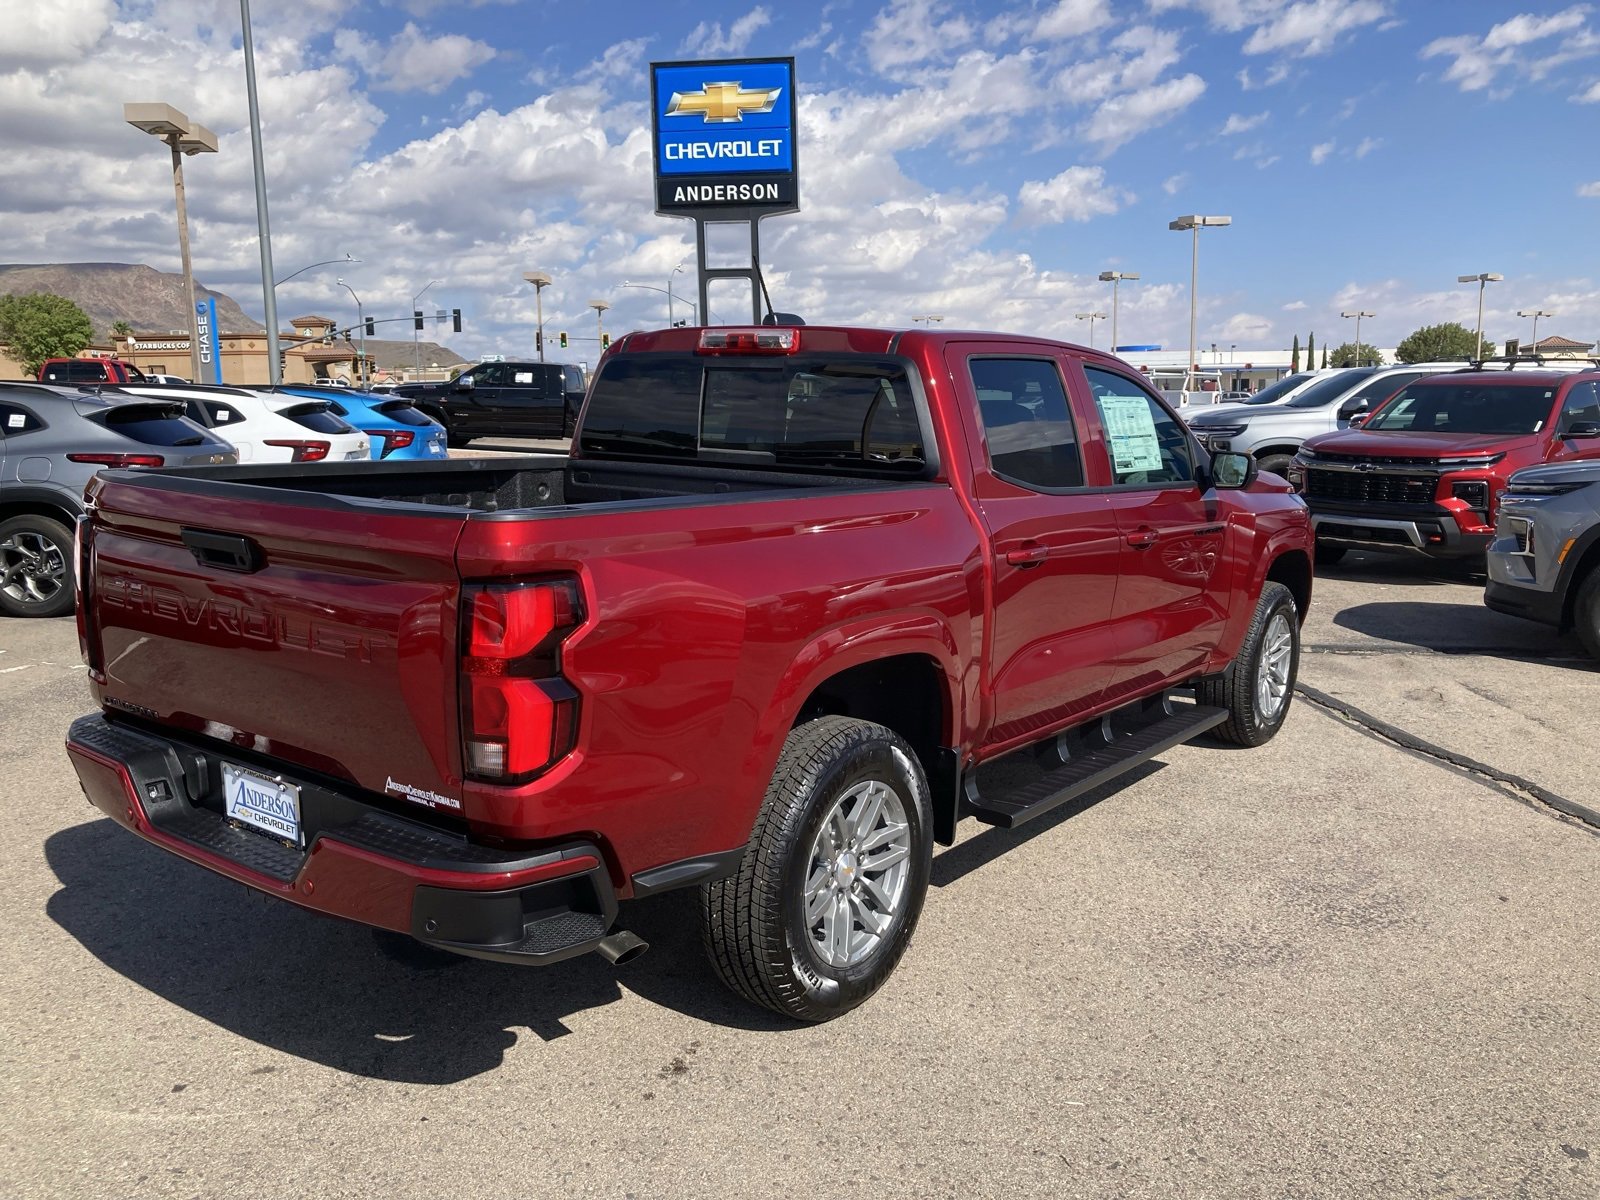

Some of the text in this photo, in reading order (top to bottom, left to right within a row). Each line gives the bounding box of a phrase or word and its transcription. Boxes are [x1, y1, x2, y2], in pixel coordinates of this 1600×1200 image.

[665, 139, 782, 160] CHEVROLET
[674, 183, 779, 202] ANDERSON
[134, 342, 191, 350] STARBUCKS COF
[197, 316, 211, 364] CHASE
[101, 575, 389, 664] CHEVROLET
[230, 780, 297, 821] ANDERSON
[254, 813, 295, 835] CHEVROLET
